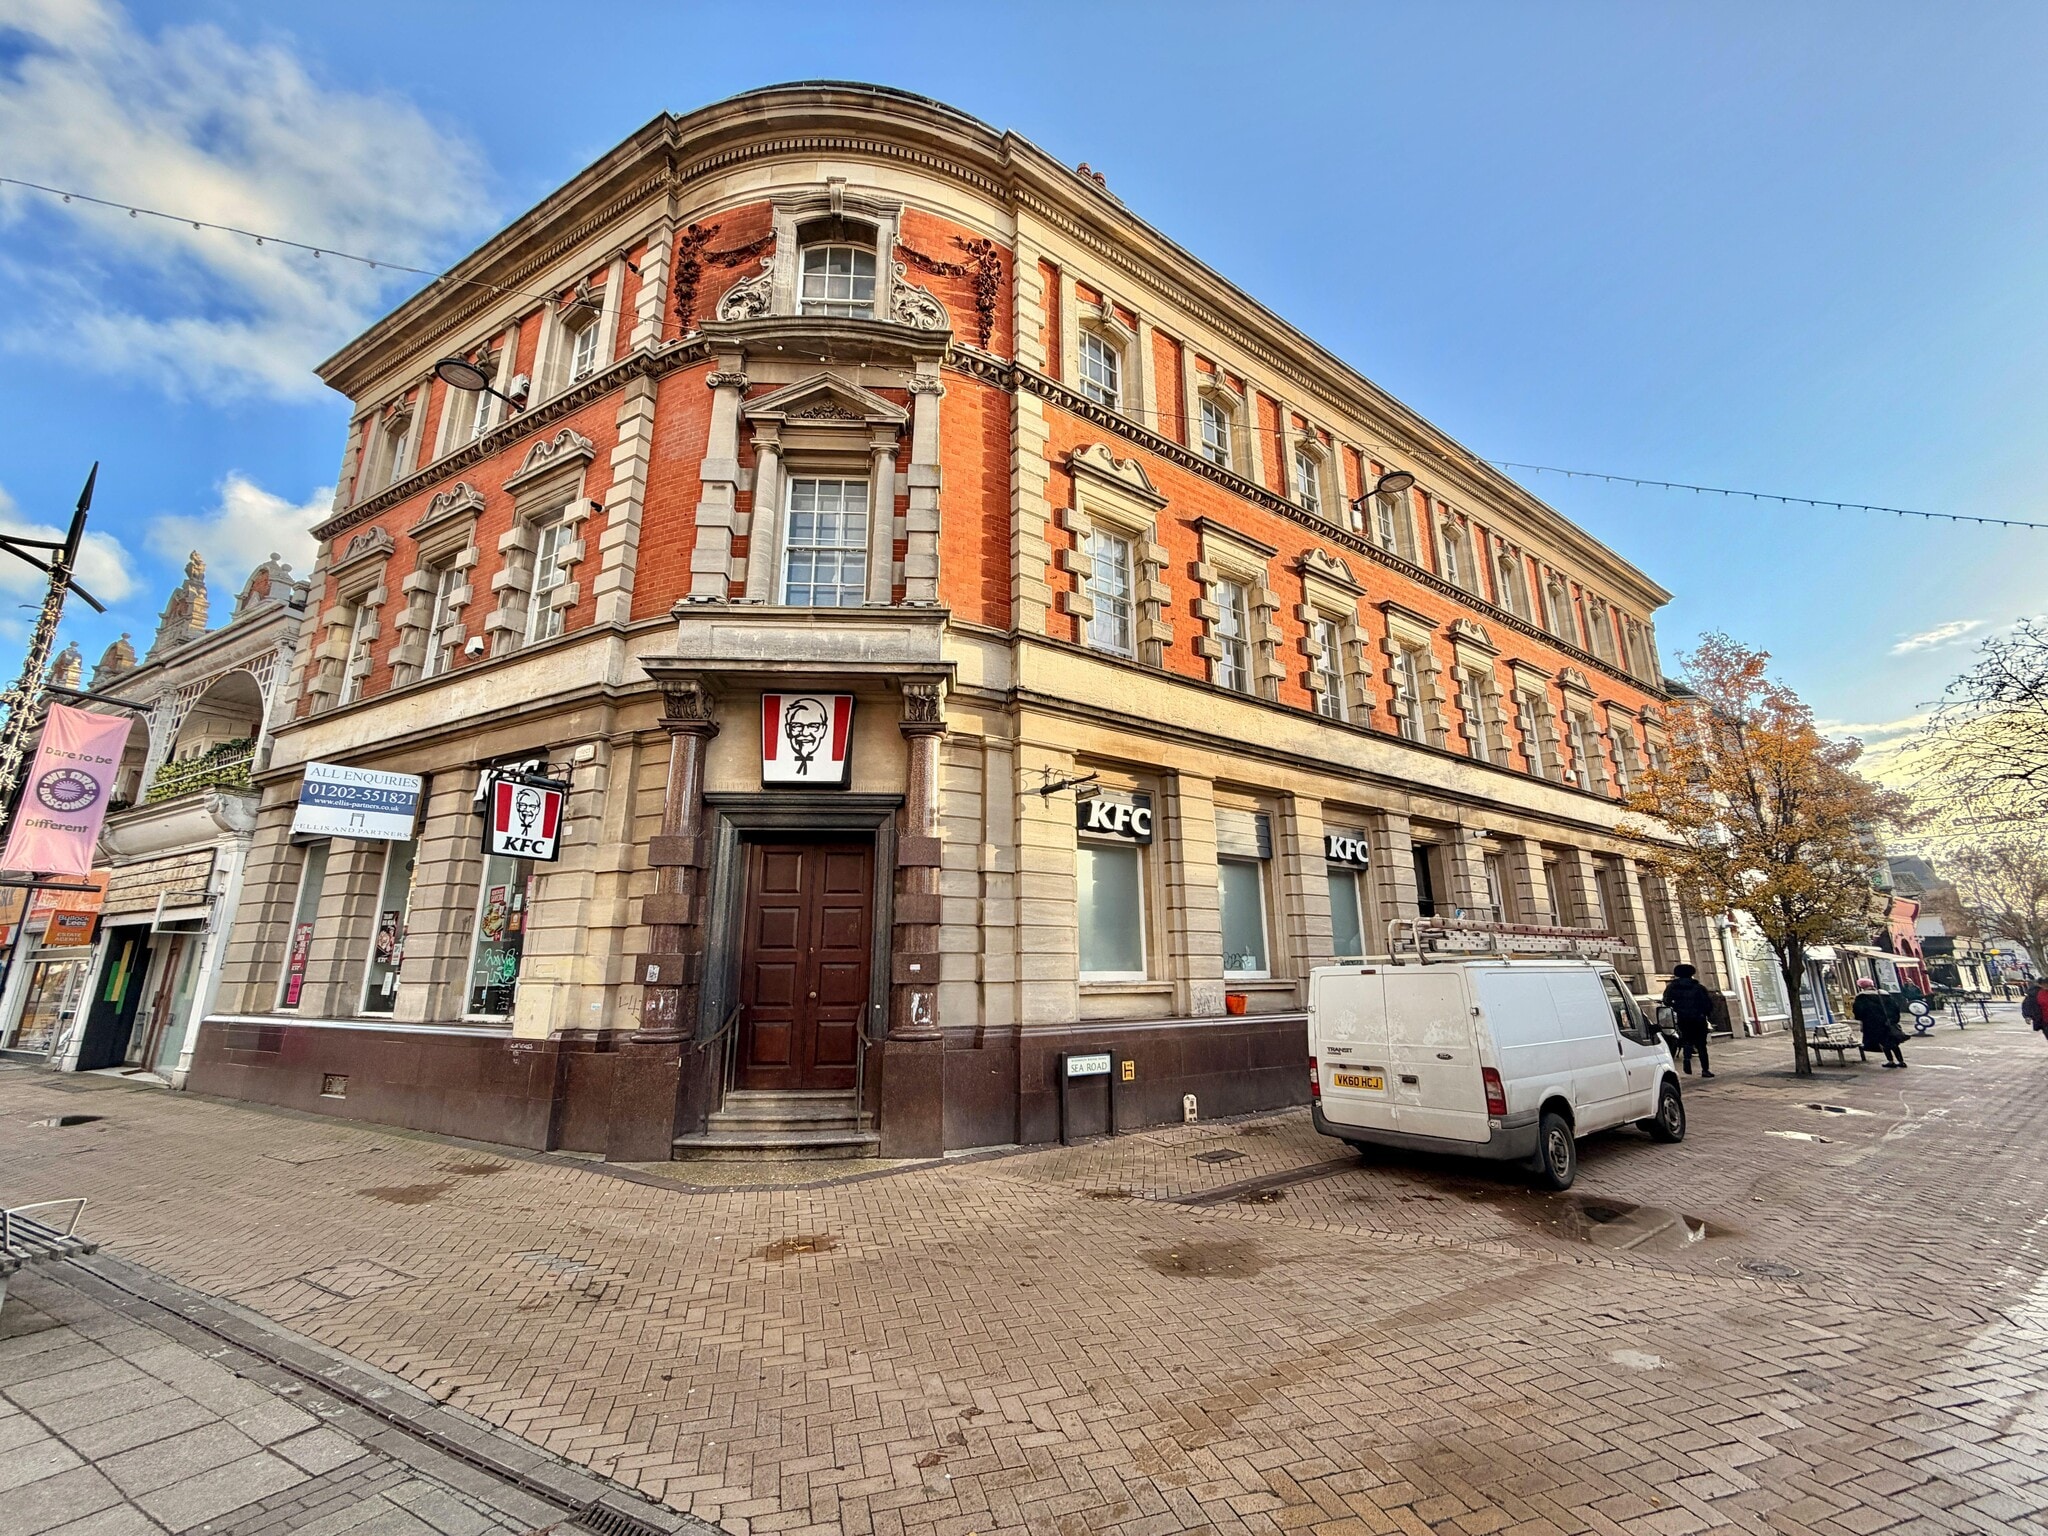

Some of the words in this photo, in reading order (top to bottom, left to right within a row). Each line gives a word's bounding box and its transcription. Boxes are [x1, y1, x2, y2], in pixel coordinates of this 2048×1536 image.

[45, 746, 75, 760] Dare
[79, 753, 92, 762] to
[95, 756, 113, 765] be
[42, 770, 67, 785] WE
[69, 771, 97, 792] ARE
[310, 767, 340, 779] ALL
[344, 770, 419, 789] ENQUIRIES
[39, 787, 96, 811] BOSCOMBE
[308, 783, 414, 806] 01202-551821
[314, 798, 400, 812] www.ellis-partners.co.uk
[24, 818, 89, 833] Different
[1087, 799, 1151, 836] KFC
[299, 823, 331, 832] ELLIS
[332, 826, 356, 834] AND
[358, 829, 409, 838] PARTNERS
[502, 836, 545, 854] KFC
[1329, 835, 1369, 863] KFC
[1071, 1064, 1084, 1073] SEA
[1086, 1061, 1107, 1072] ROAD
[1337, 1075, 1360, 1087] VK60
[1361, 1077, 1380, 1089] HCJ
